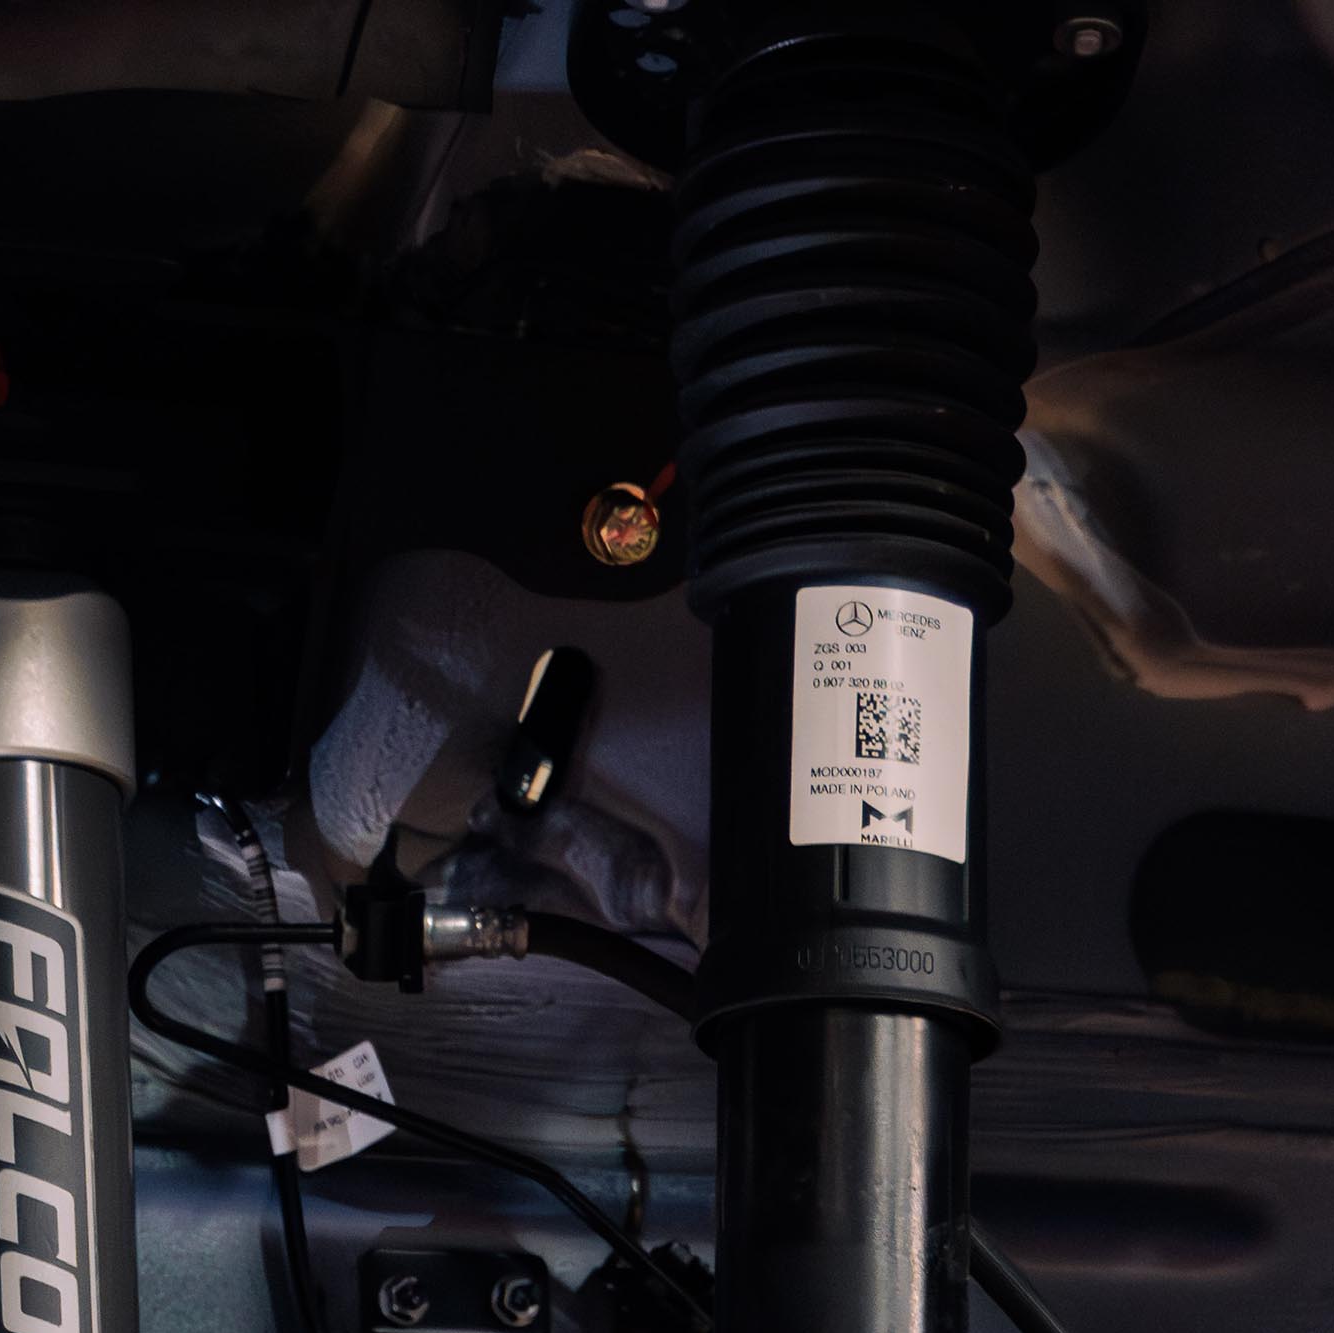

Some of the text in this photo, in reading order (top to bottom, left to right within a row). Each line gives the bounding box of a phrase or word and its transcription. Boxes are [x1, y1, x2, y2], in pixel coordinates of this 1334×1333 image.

[813, 643, 867, 654] ZGS 003
[830, 660, 851, 671] 001
[823, 677, 845, 688] 907
[848, 677, 870, 688] 320
[810, 783, 916, 800] MADE IN POLAND
